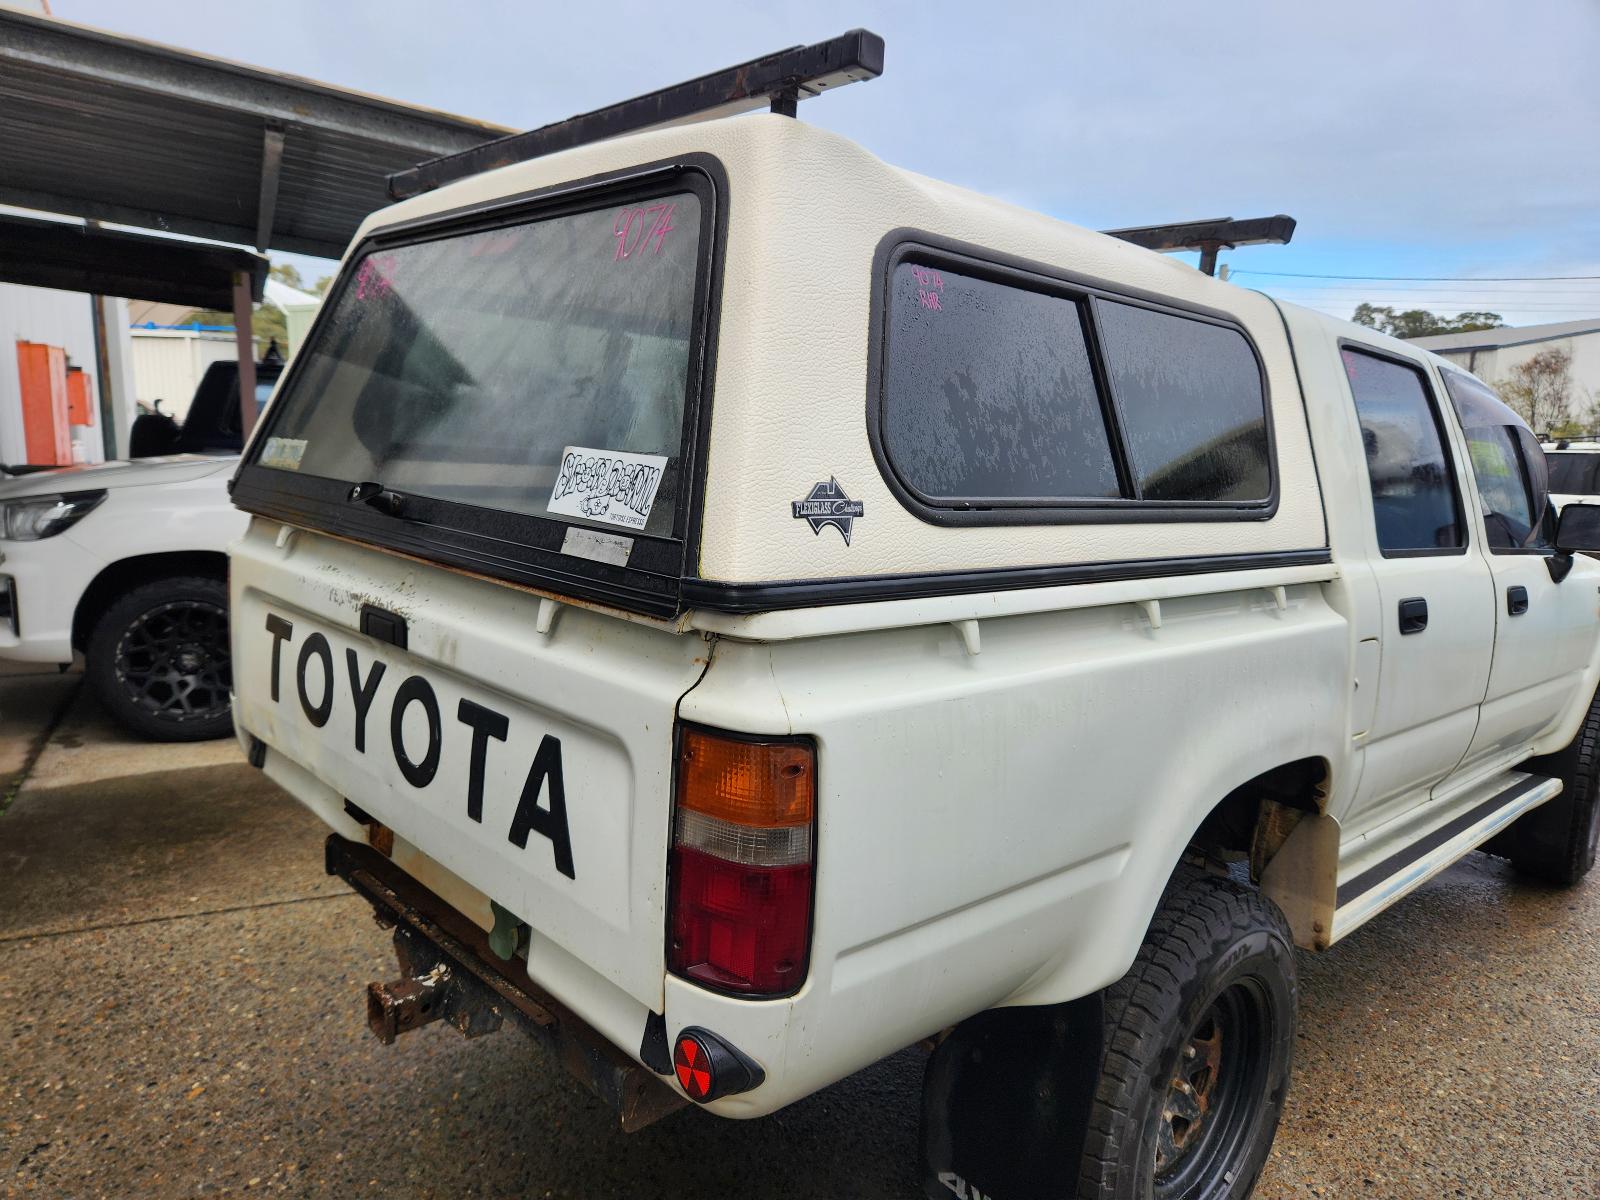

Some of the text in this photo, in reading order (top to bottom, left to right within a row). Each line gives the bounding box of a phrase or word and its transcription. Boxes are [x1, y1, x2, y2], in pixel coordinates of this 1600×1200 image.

[613, 202, 677, 262] 9074
[795, 501, 832, 517] FLEXIGLASS
[265, 612, 576, 880] TOYOTA
